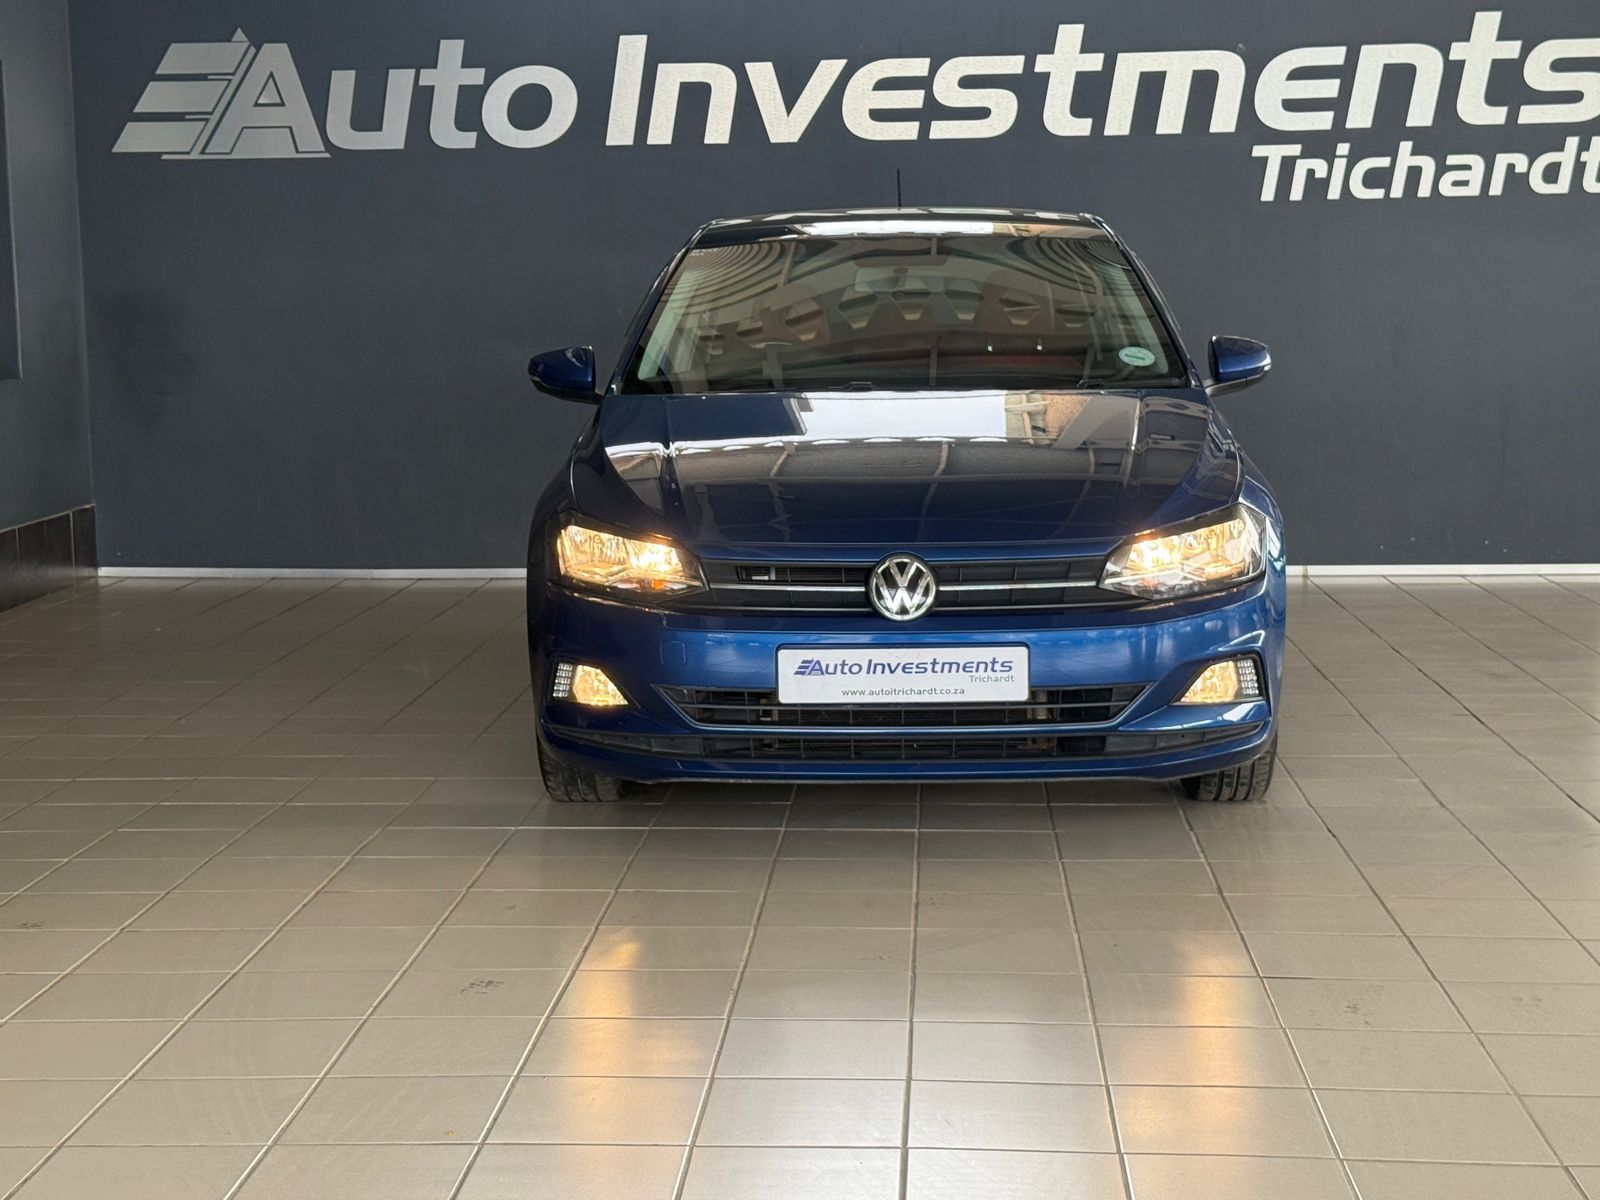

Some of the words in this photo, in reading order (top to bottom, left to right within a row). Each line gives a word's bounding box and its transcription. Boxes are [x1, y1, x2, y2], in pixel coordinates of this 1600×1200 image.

[203, 38, 579, 156] Auto
[605, 10, 1600, 146] Investments
[873, 558, 934, 618] VW
[807, 658, 863, 676] Auto
[866, 656, 1013, 675] Investments
[969, 674, 1015, 683] Trichardt
[841, 687, 965, 697] www.autoitrichardt.co.za
